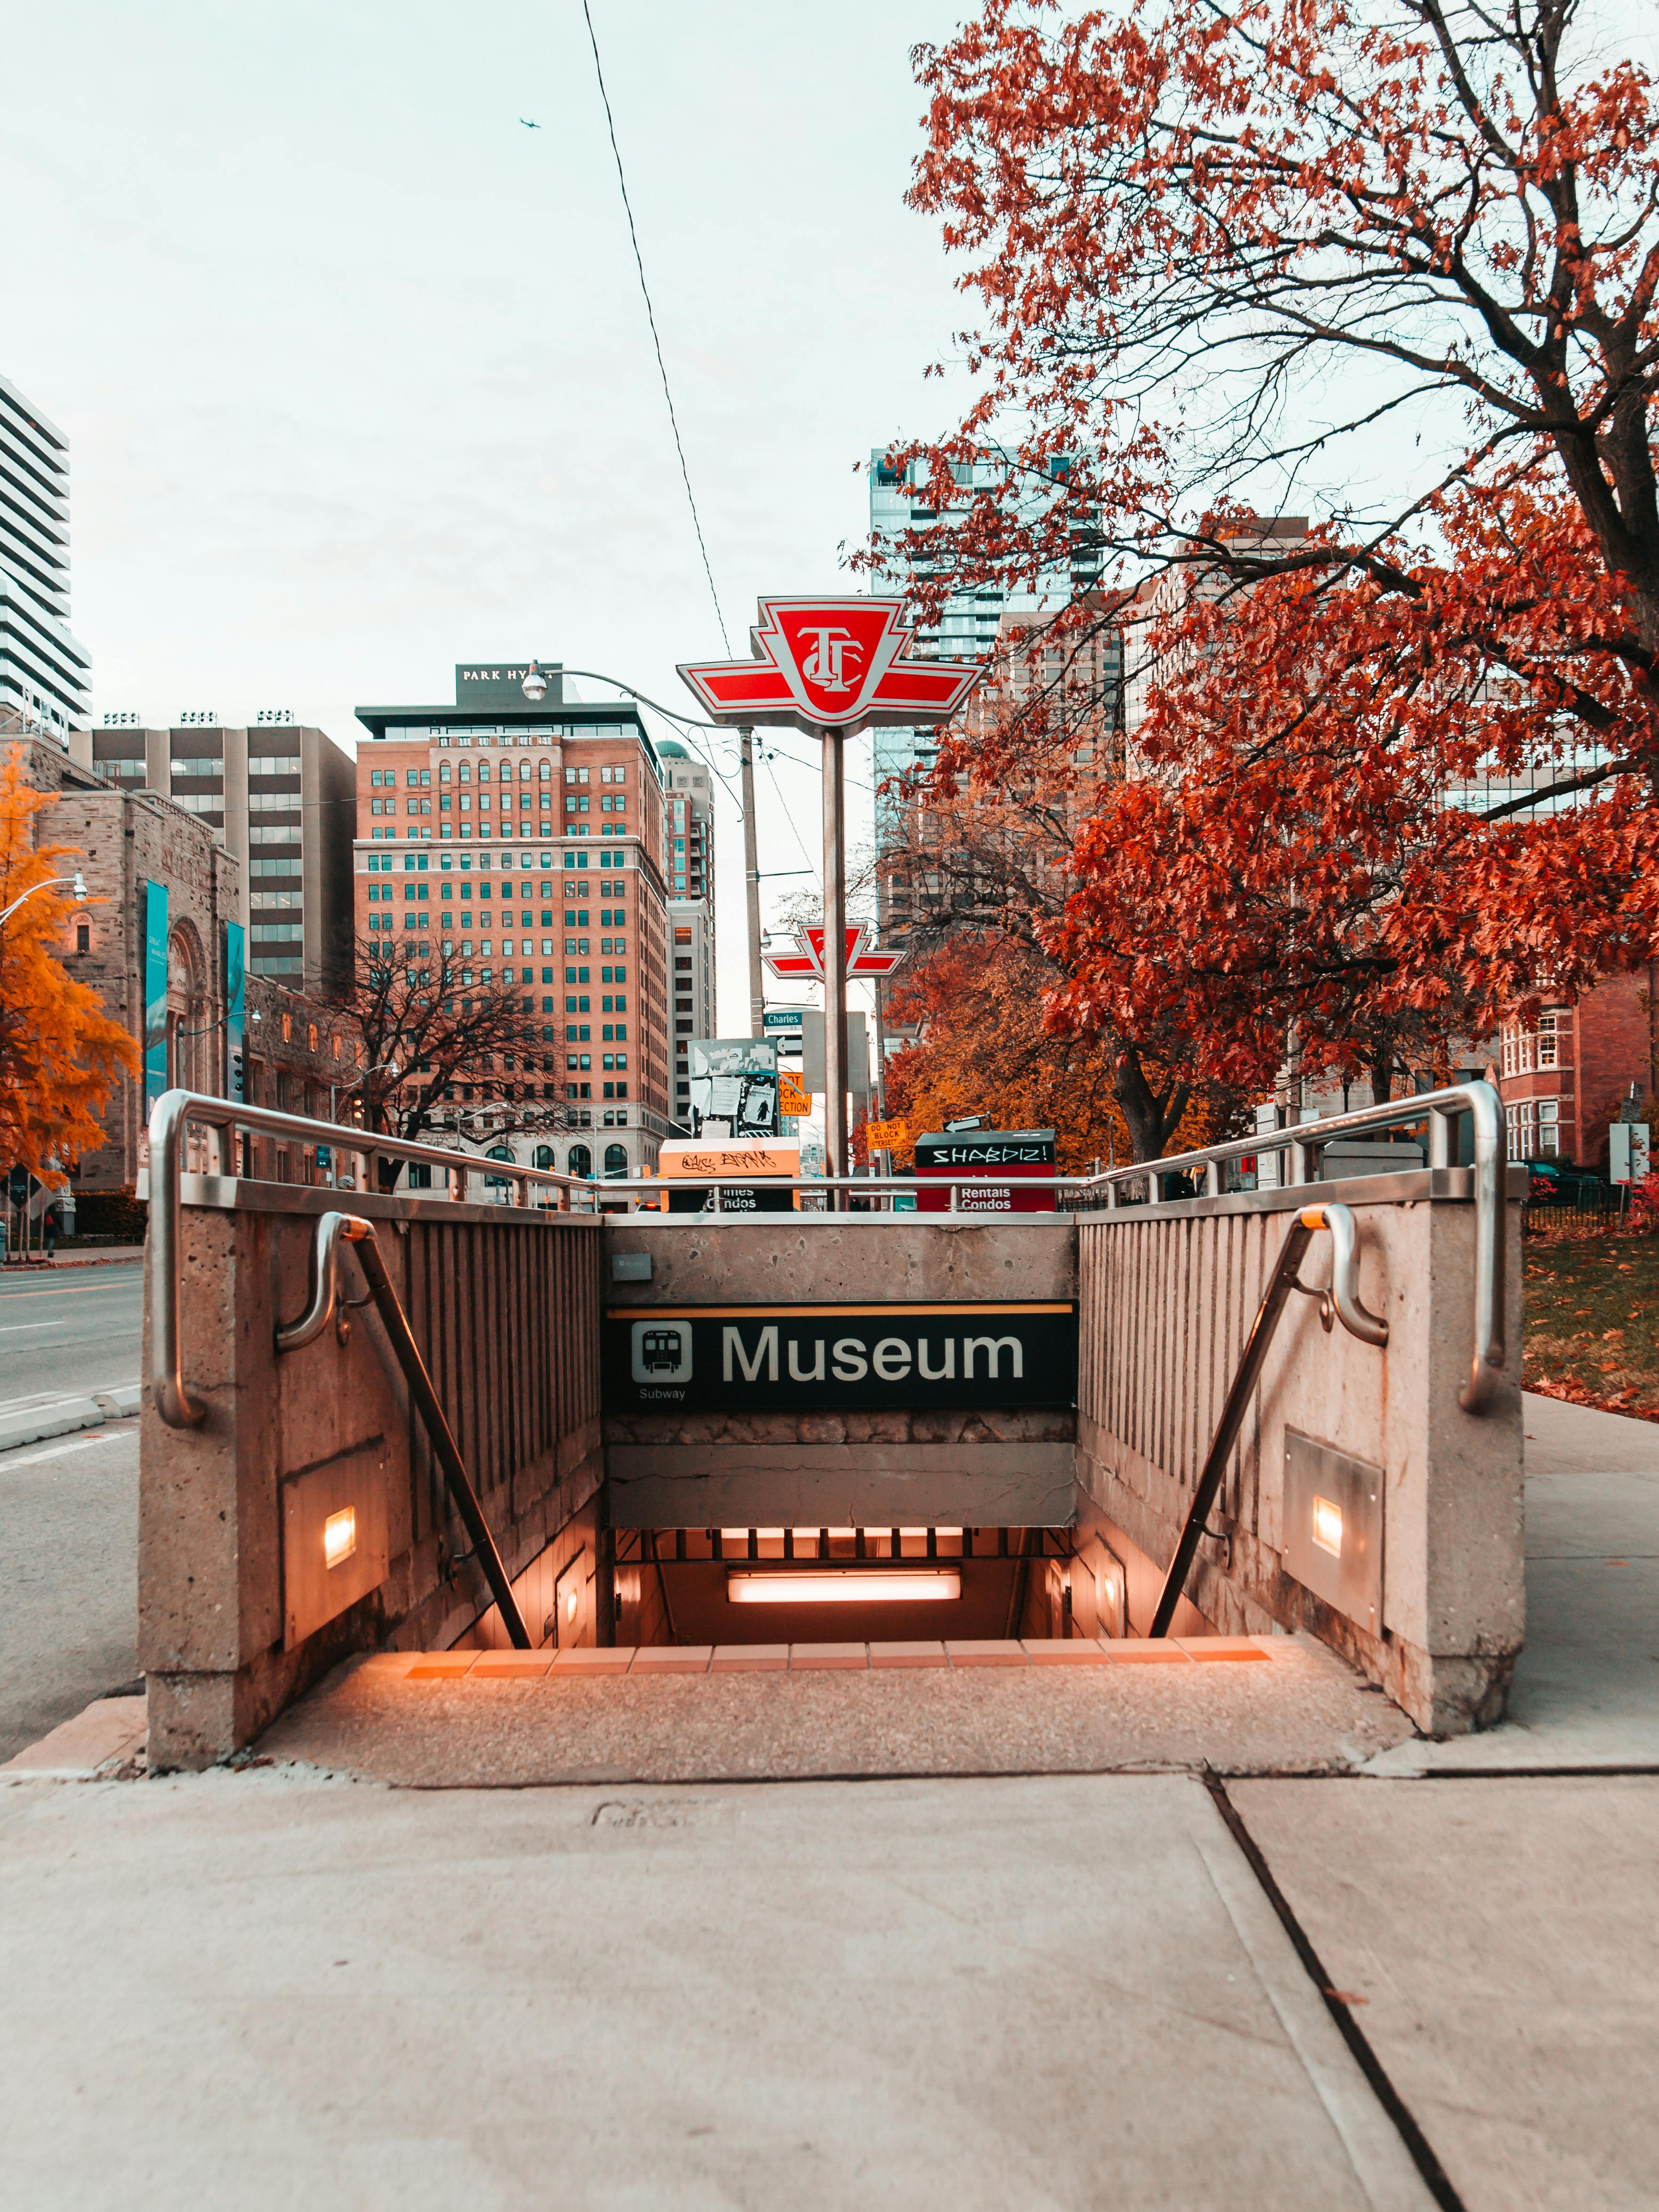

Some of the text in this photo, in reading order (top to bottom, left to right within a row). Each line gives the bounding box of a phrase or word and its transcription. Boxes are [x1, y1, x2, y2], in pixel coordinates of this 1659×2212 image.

[463, 670, 500, 680] PARK
[768, 1014, 798, 1024] Charles
[875, 1131, 899, 1139] BLOCK
[870, 1139, 906, 1148] INTERSECTION
[961, 1188, 1011, 1199] Rentals
[706, 1197, 757, 1209] Cndos
[961, 1199, 1011, 1210] Condos
[722, 1326, 1023, 1382] Museum
[639, 1388, 685, 1401] Subway
